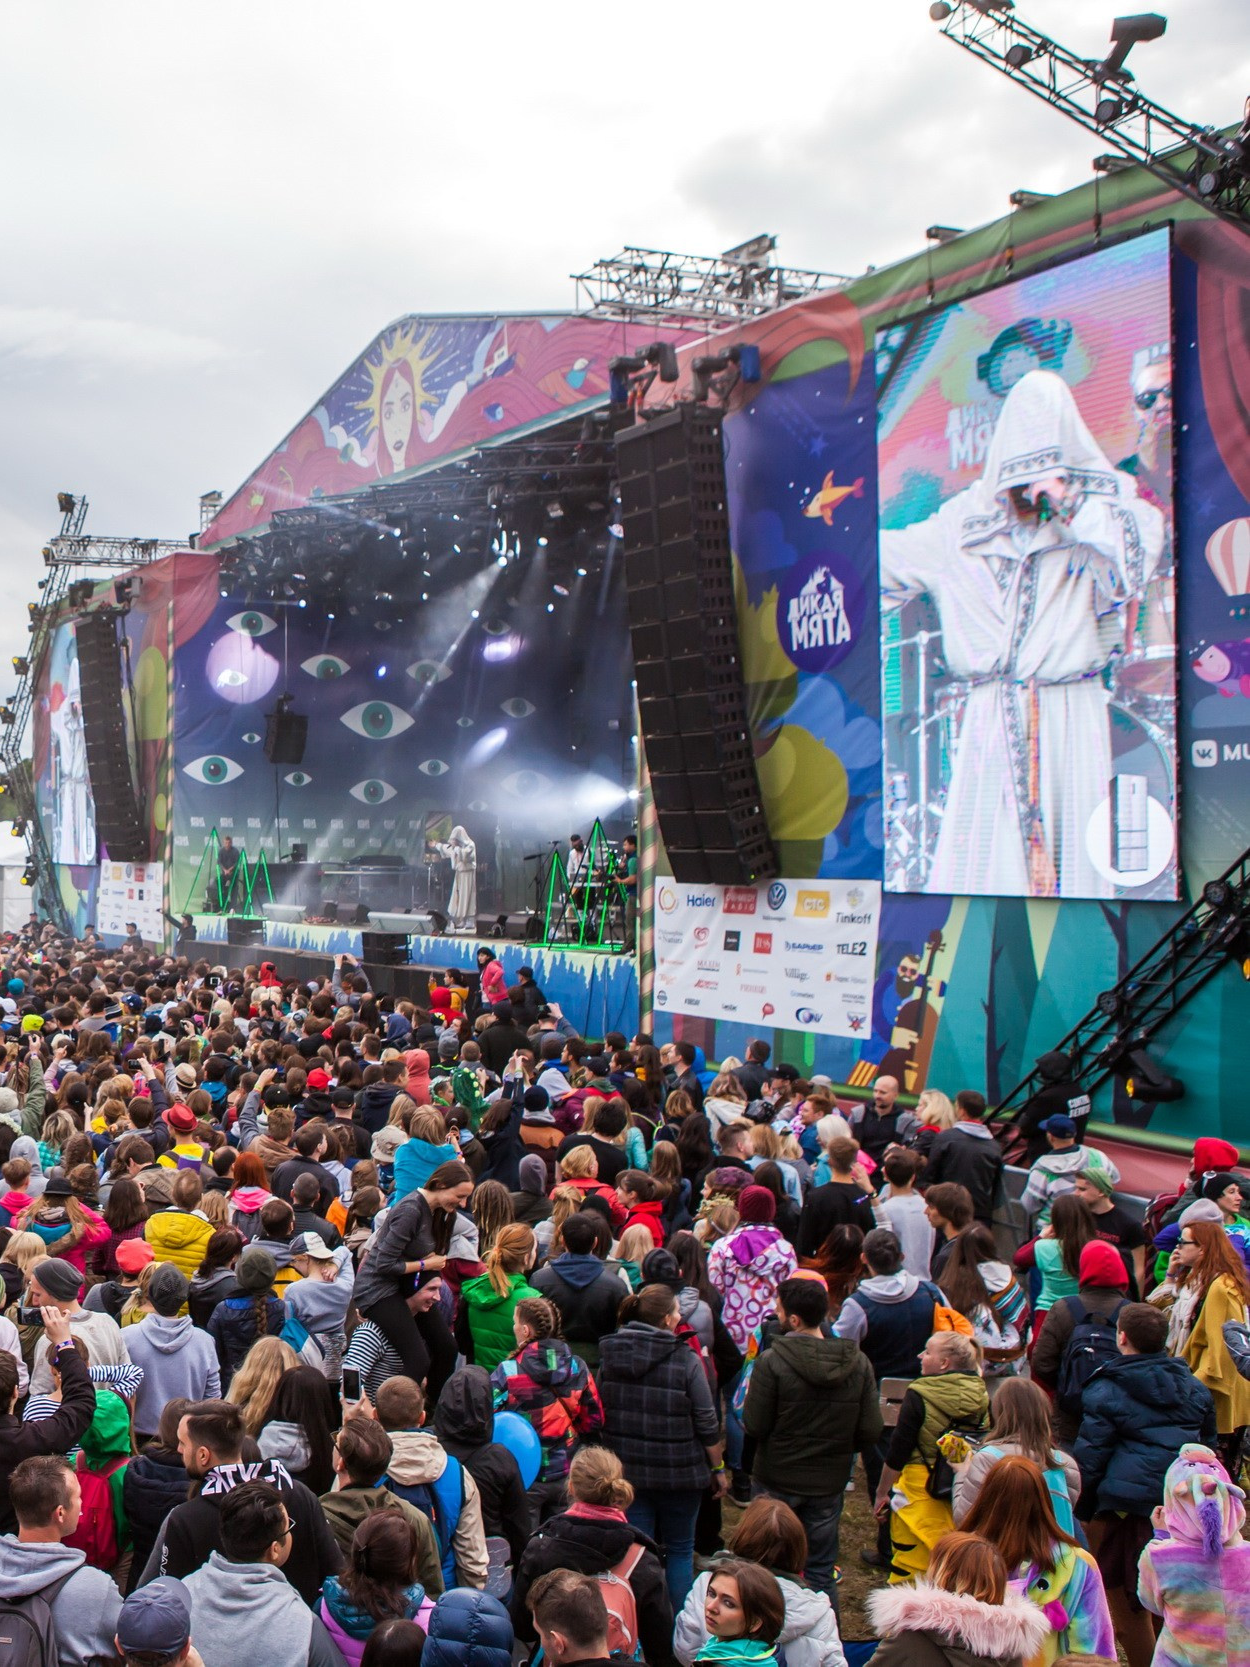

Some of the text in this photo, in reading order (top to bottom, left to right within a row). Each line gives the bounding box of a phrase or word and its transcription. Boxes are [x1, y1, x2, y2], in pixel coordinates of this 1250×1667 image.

[949, 422, 994, 471] МЯ
[787, 589, 844, 623] ДИКАЯ
[791, 609, 851, 652] МЯТА
[686, 893, 716, 907] Haier
[836, 912, 872, 924] Tinkoff
[837, 942, 867, 956] TELE2
